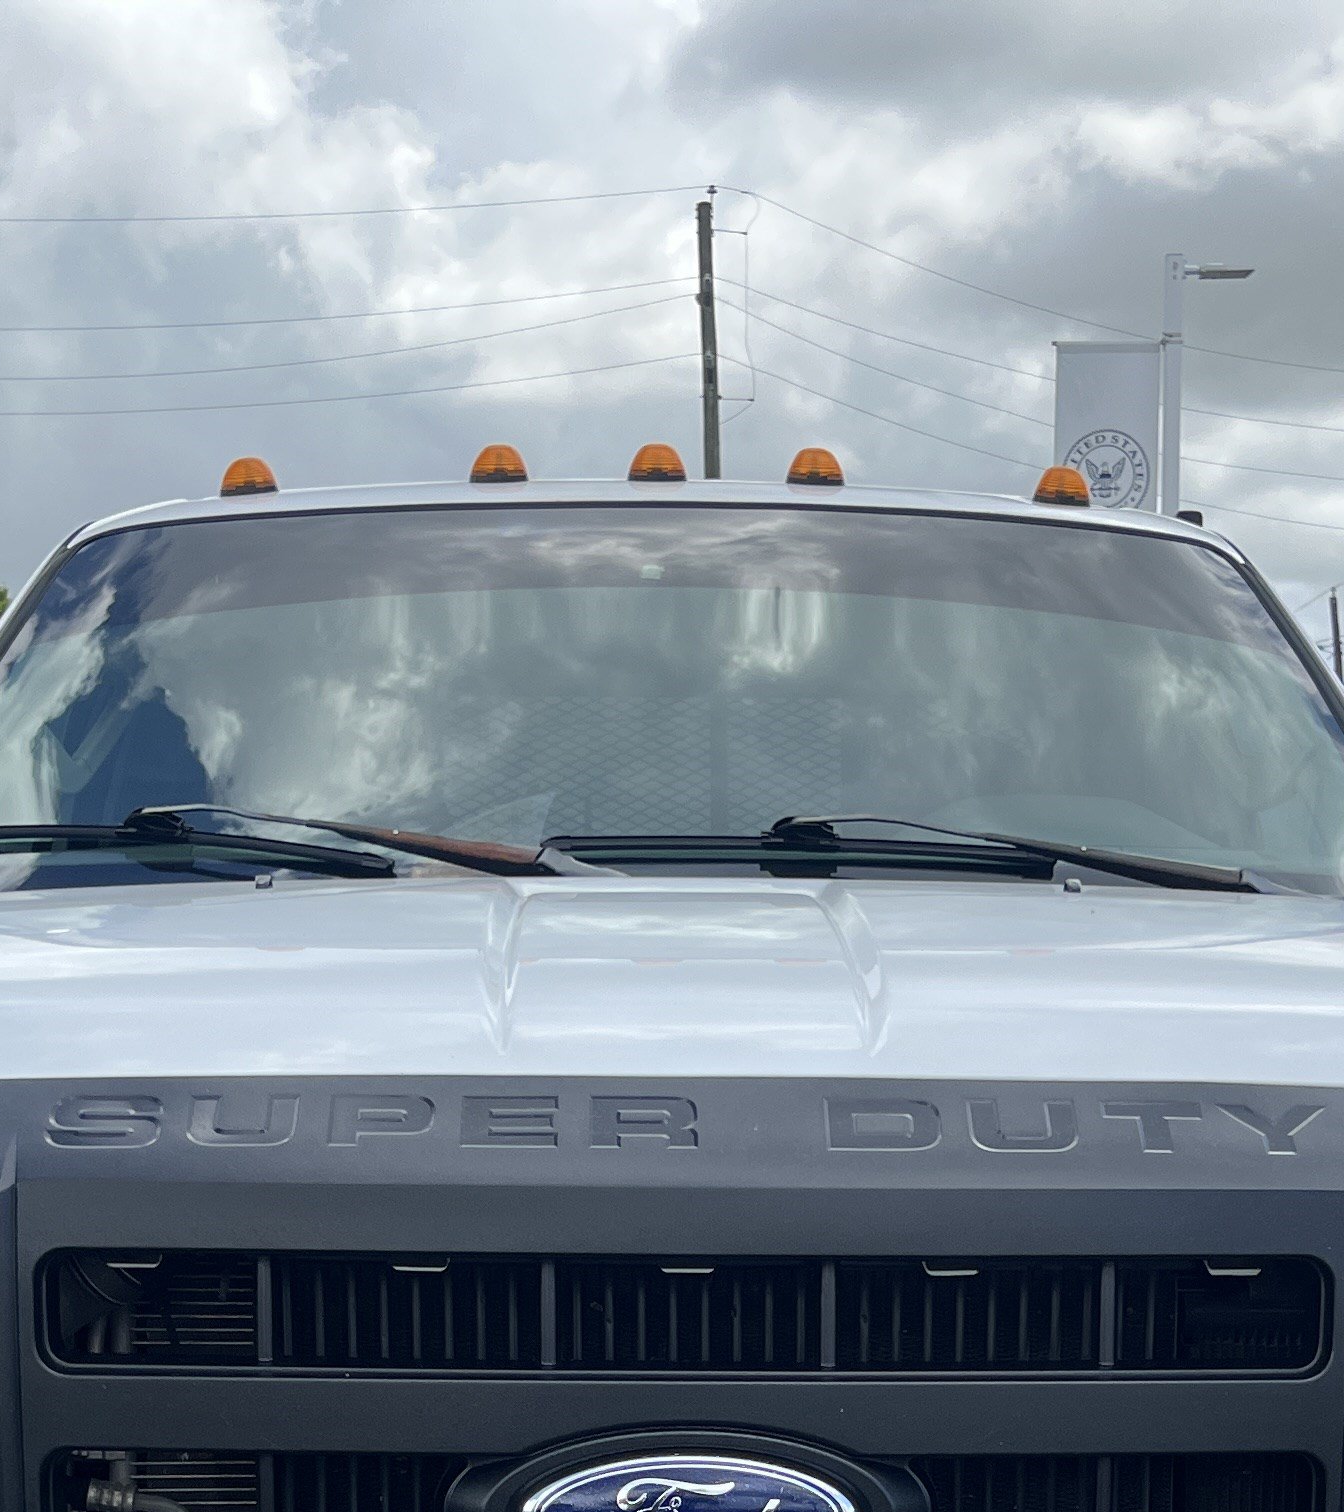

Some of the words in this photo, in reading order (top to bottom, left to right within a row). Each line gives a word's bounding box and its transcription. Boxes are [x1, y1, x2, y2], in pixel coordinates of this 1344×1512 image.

[1069, 433, 1107, 465] ITED
[1110, 434, 1145, 494] STATES
[42, 1095, 699, 1149] SUPER
[822, 1098, 1326, 1155] DUTY
